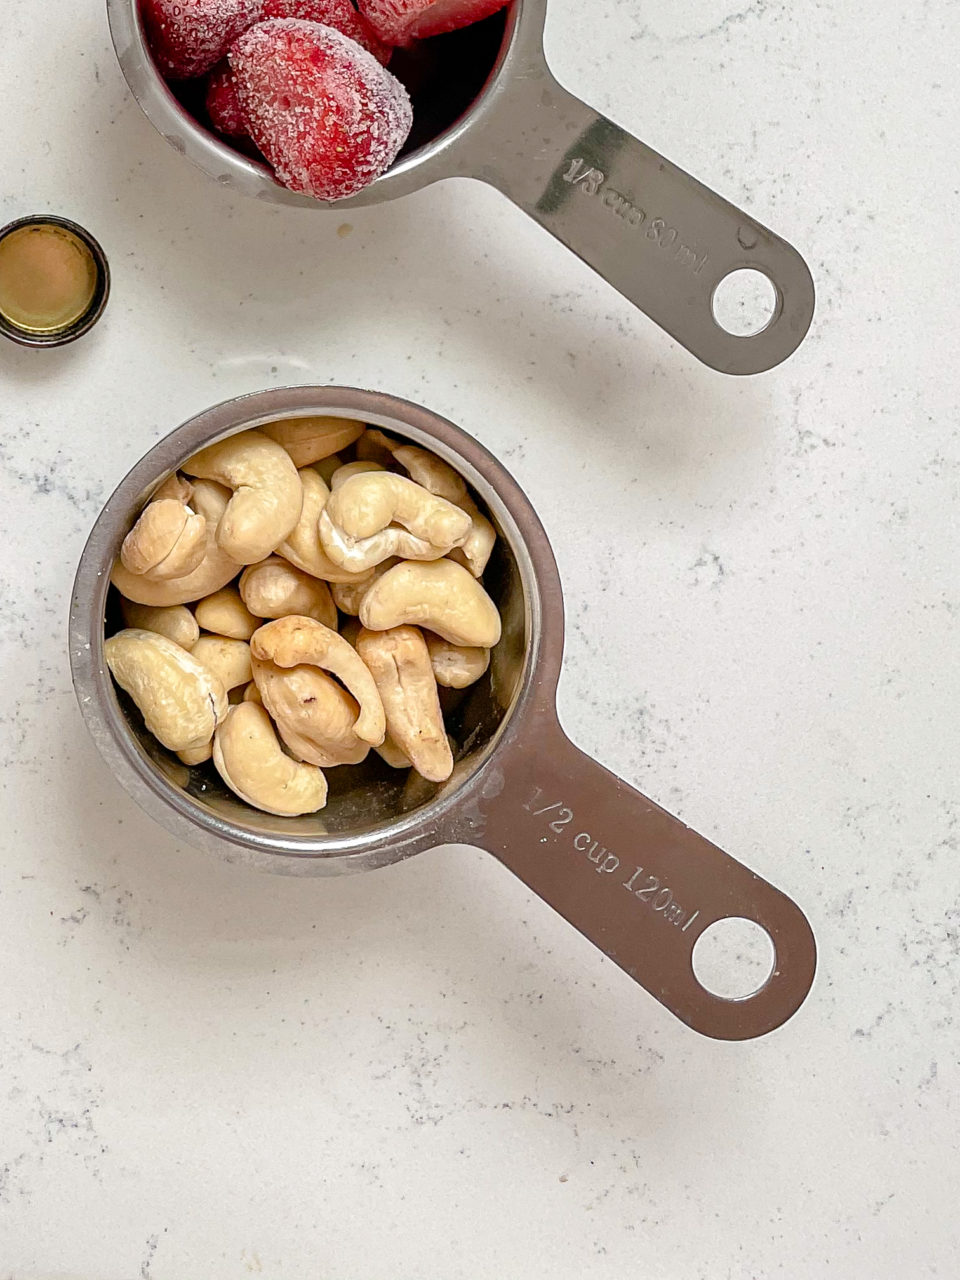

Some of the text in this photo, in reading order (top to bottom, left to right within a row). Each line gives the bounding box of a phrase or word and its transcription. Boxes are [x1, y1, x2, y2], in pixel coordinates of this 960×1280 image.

[522, 787, 700, 932] 1/2 cup 120ml
